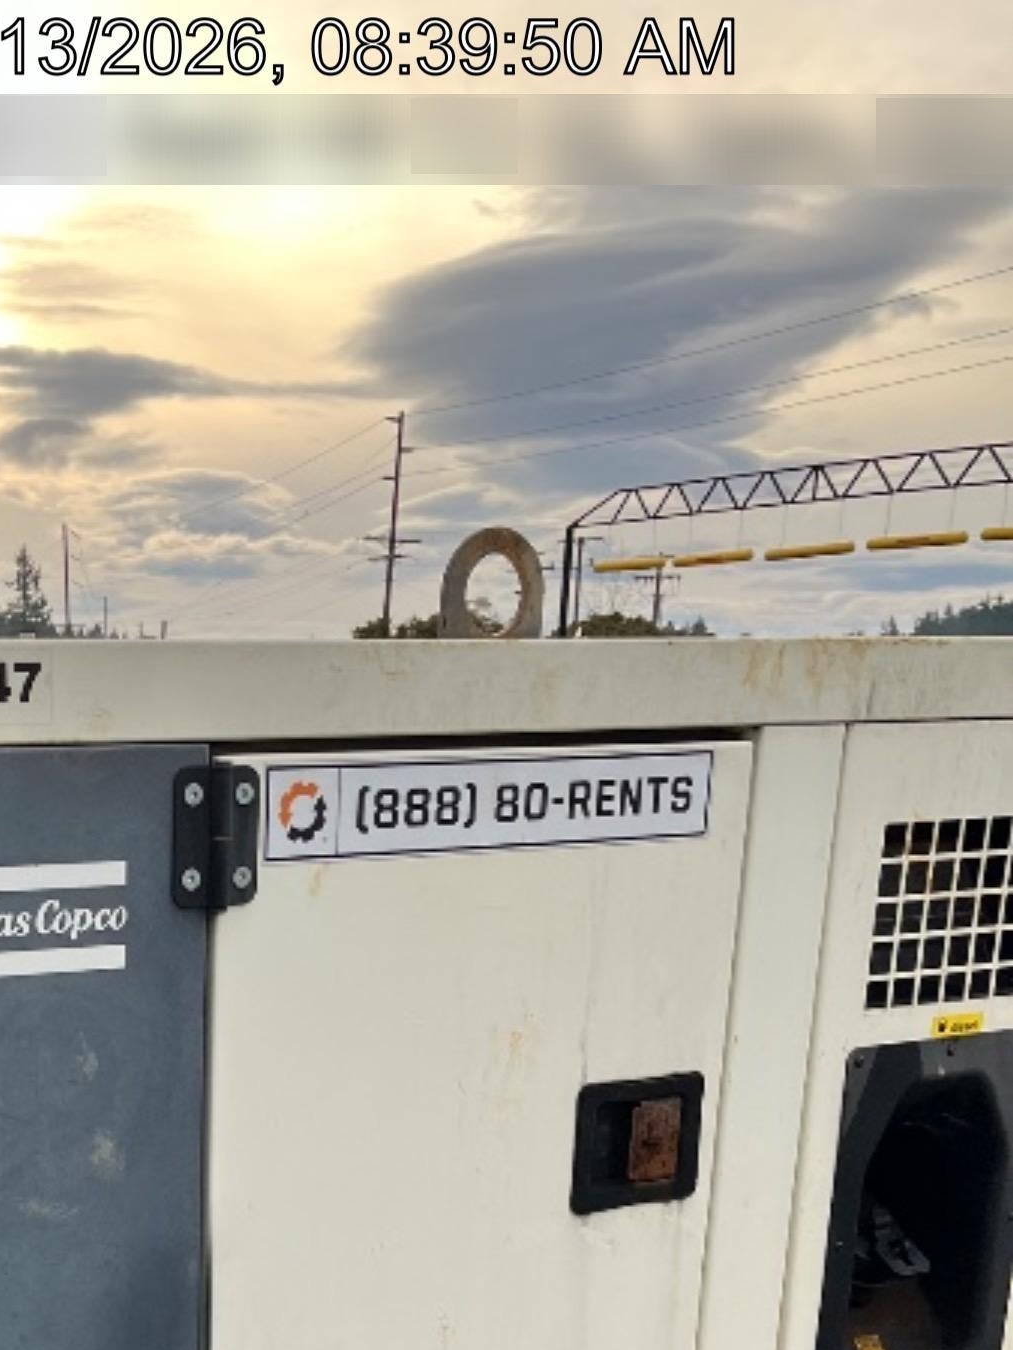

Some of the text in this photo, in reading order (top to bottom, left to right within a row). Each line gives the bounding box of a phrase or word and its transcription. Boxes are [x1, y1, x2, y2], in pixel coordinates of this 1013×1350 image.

[355, 775, 693, 835] (888) 80-RENTS
[35, 899, 128, 940] Copco
